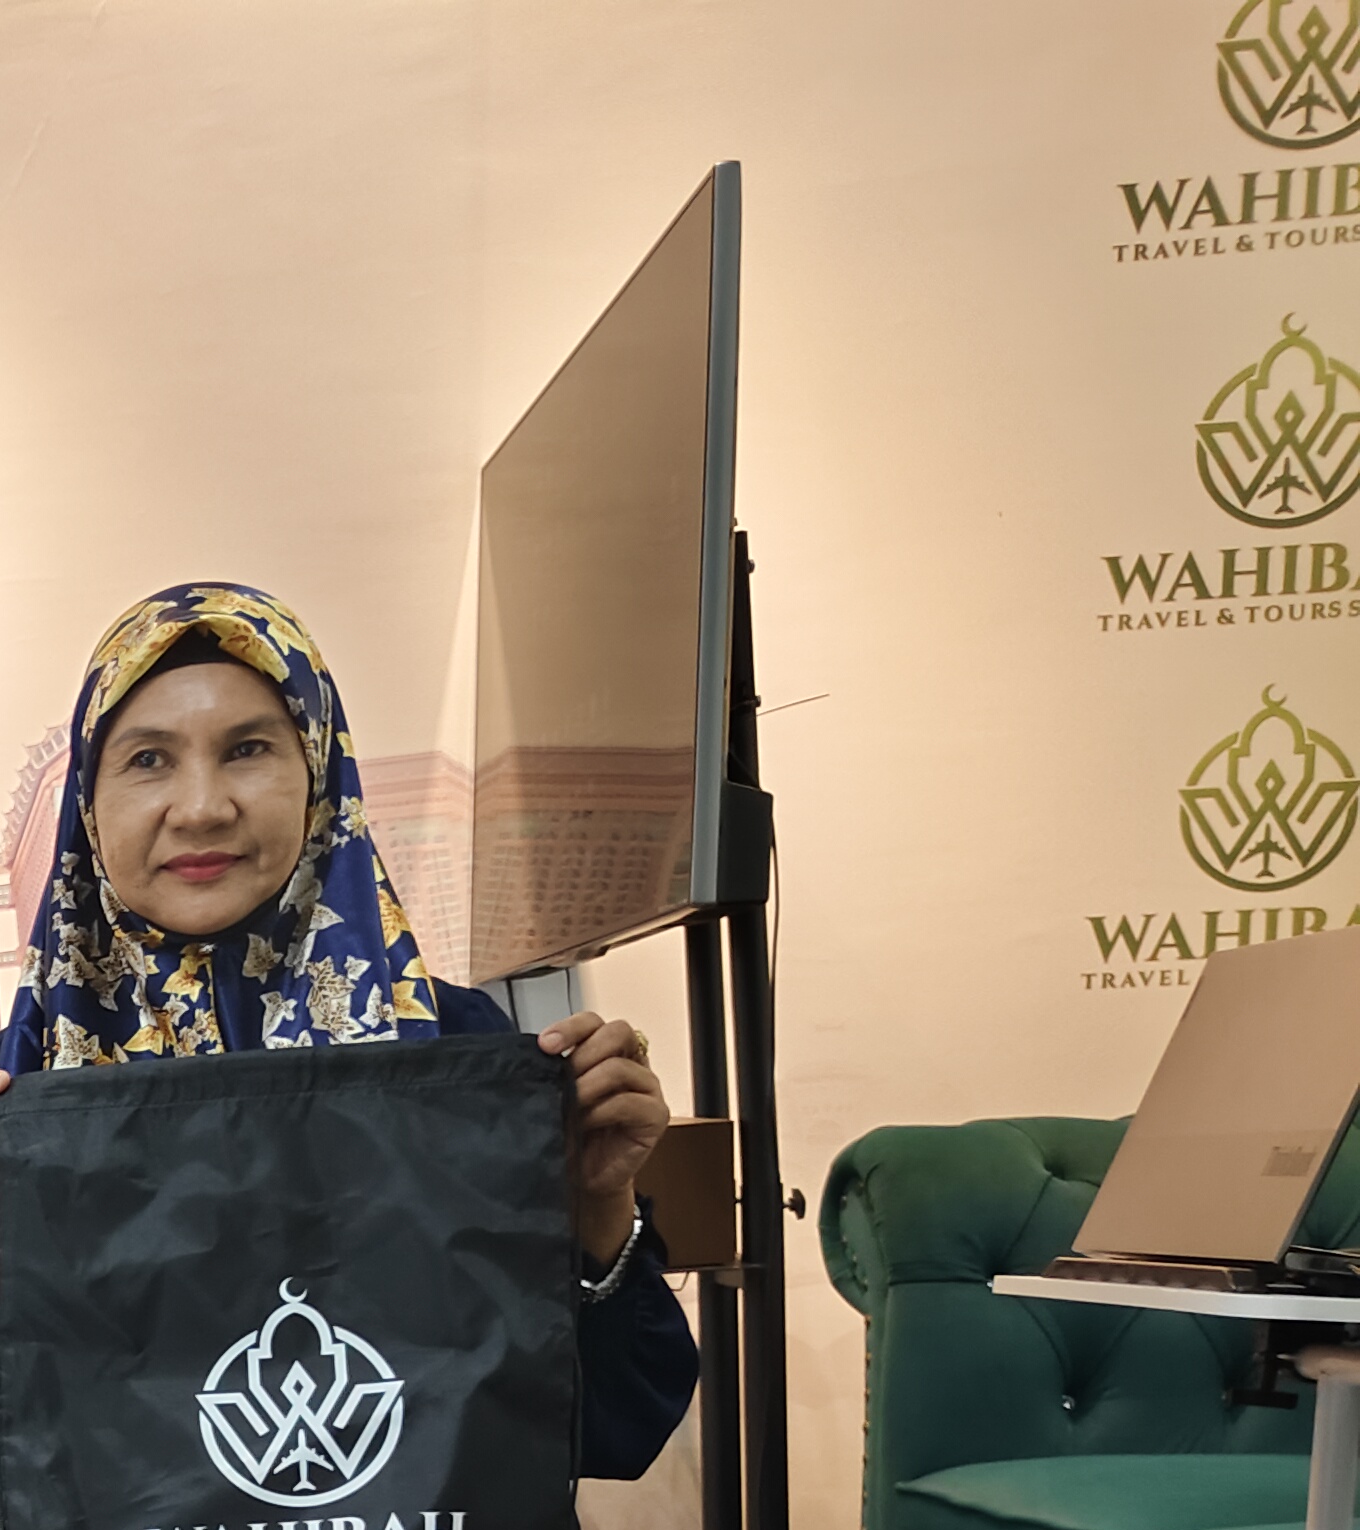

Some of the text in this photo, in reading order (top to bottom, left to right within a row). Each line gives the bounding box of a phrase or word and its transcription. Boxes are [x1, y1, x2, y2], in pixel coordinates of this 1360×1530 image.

[1113, 237, 1226, 262] TRAVEL
[1235, 234, 1254, 251] &
[1097, 610, 1208, 632] TRAVEL
[1217, 607, 1235, 625] &
[1244, 601, 1342, 624] TOURS
[1081, 969, 1189, 990] TRAVEL
